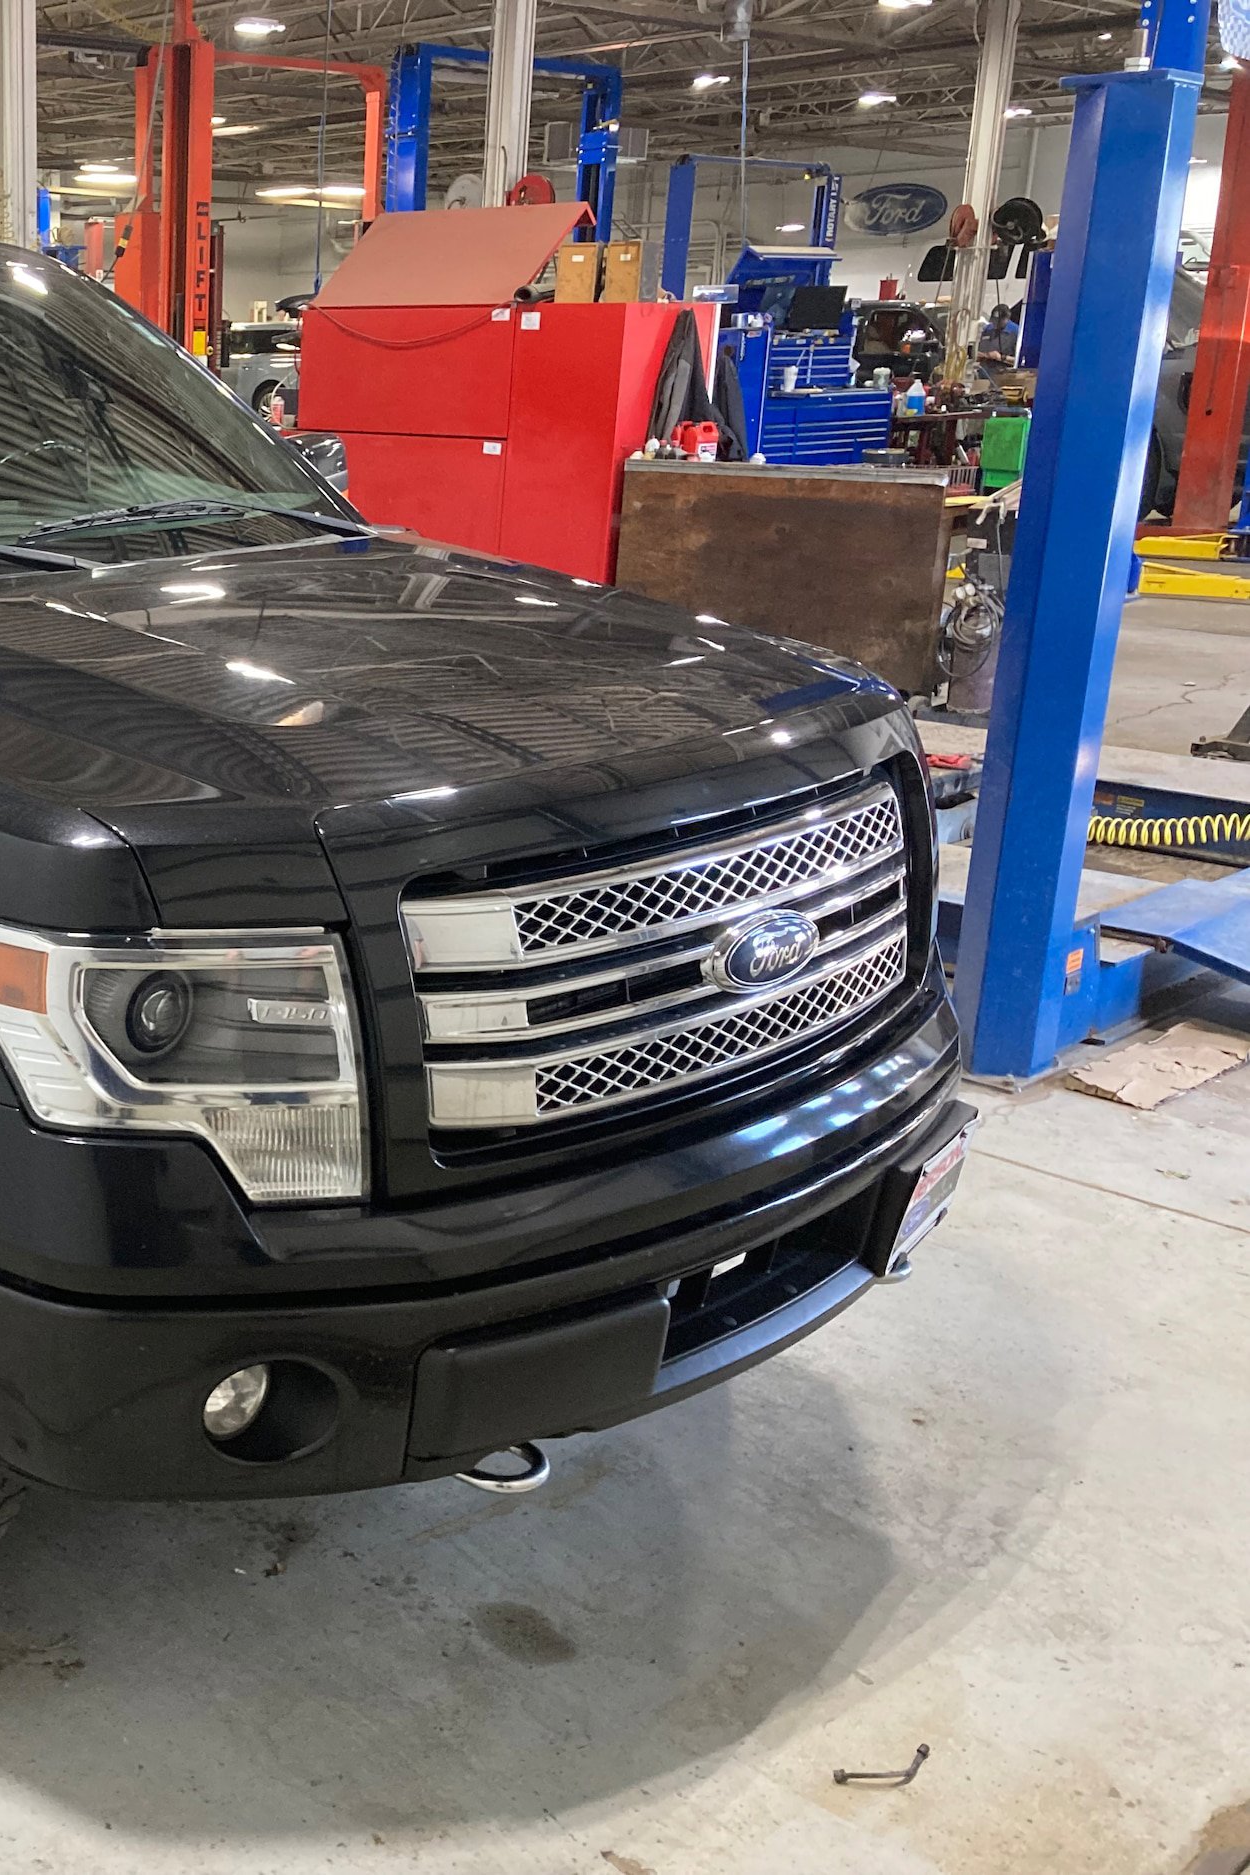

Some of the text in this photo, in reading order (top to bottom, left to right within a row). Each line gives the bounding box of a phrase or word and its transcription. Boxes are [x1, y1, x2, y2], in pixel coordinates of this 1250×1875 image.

[825, 198, 838, 237] ROTARY
[864, 193, 926, 225] Ford
[194, 221, 207, 312] LIFT
[749, 926, 805, 978] Ford
